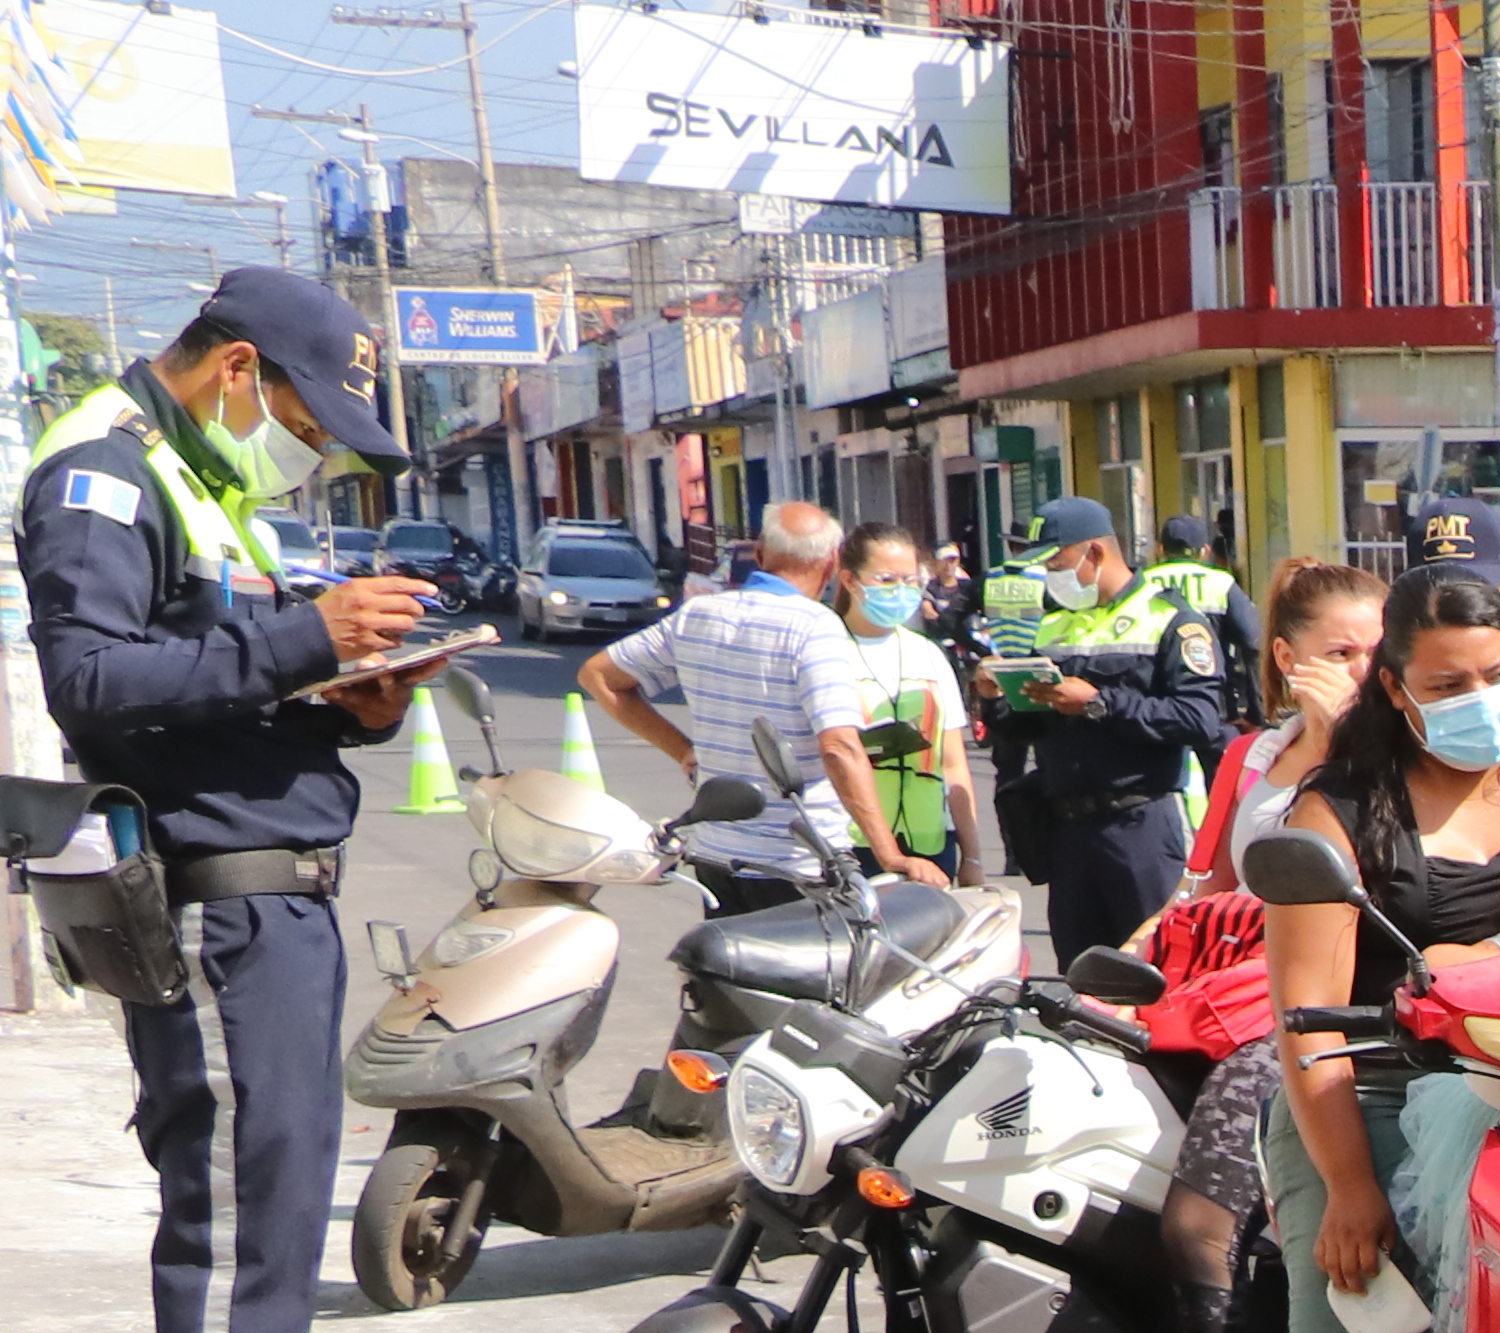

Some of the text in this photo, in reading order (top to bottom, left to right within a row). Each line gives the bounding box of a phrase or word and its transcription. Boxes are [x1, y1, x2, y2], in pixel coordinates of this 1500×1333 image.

[646, 91, 955, 168] SEVILLANA
[450, 306, 515, 323] SHERWIN
[1426, 514, 1471, 540] PMT
[977, 1126, 1043, 1140] HONDA
